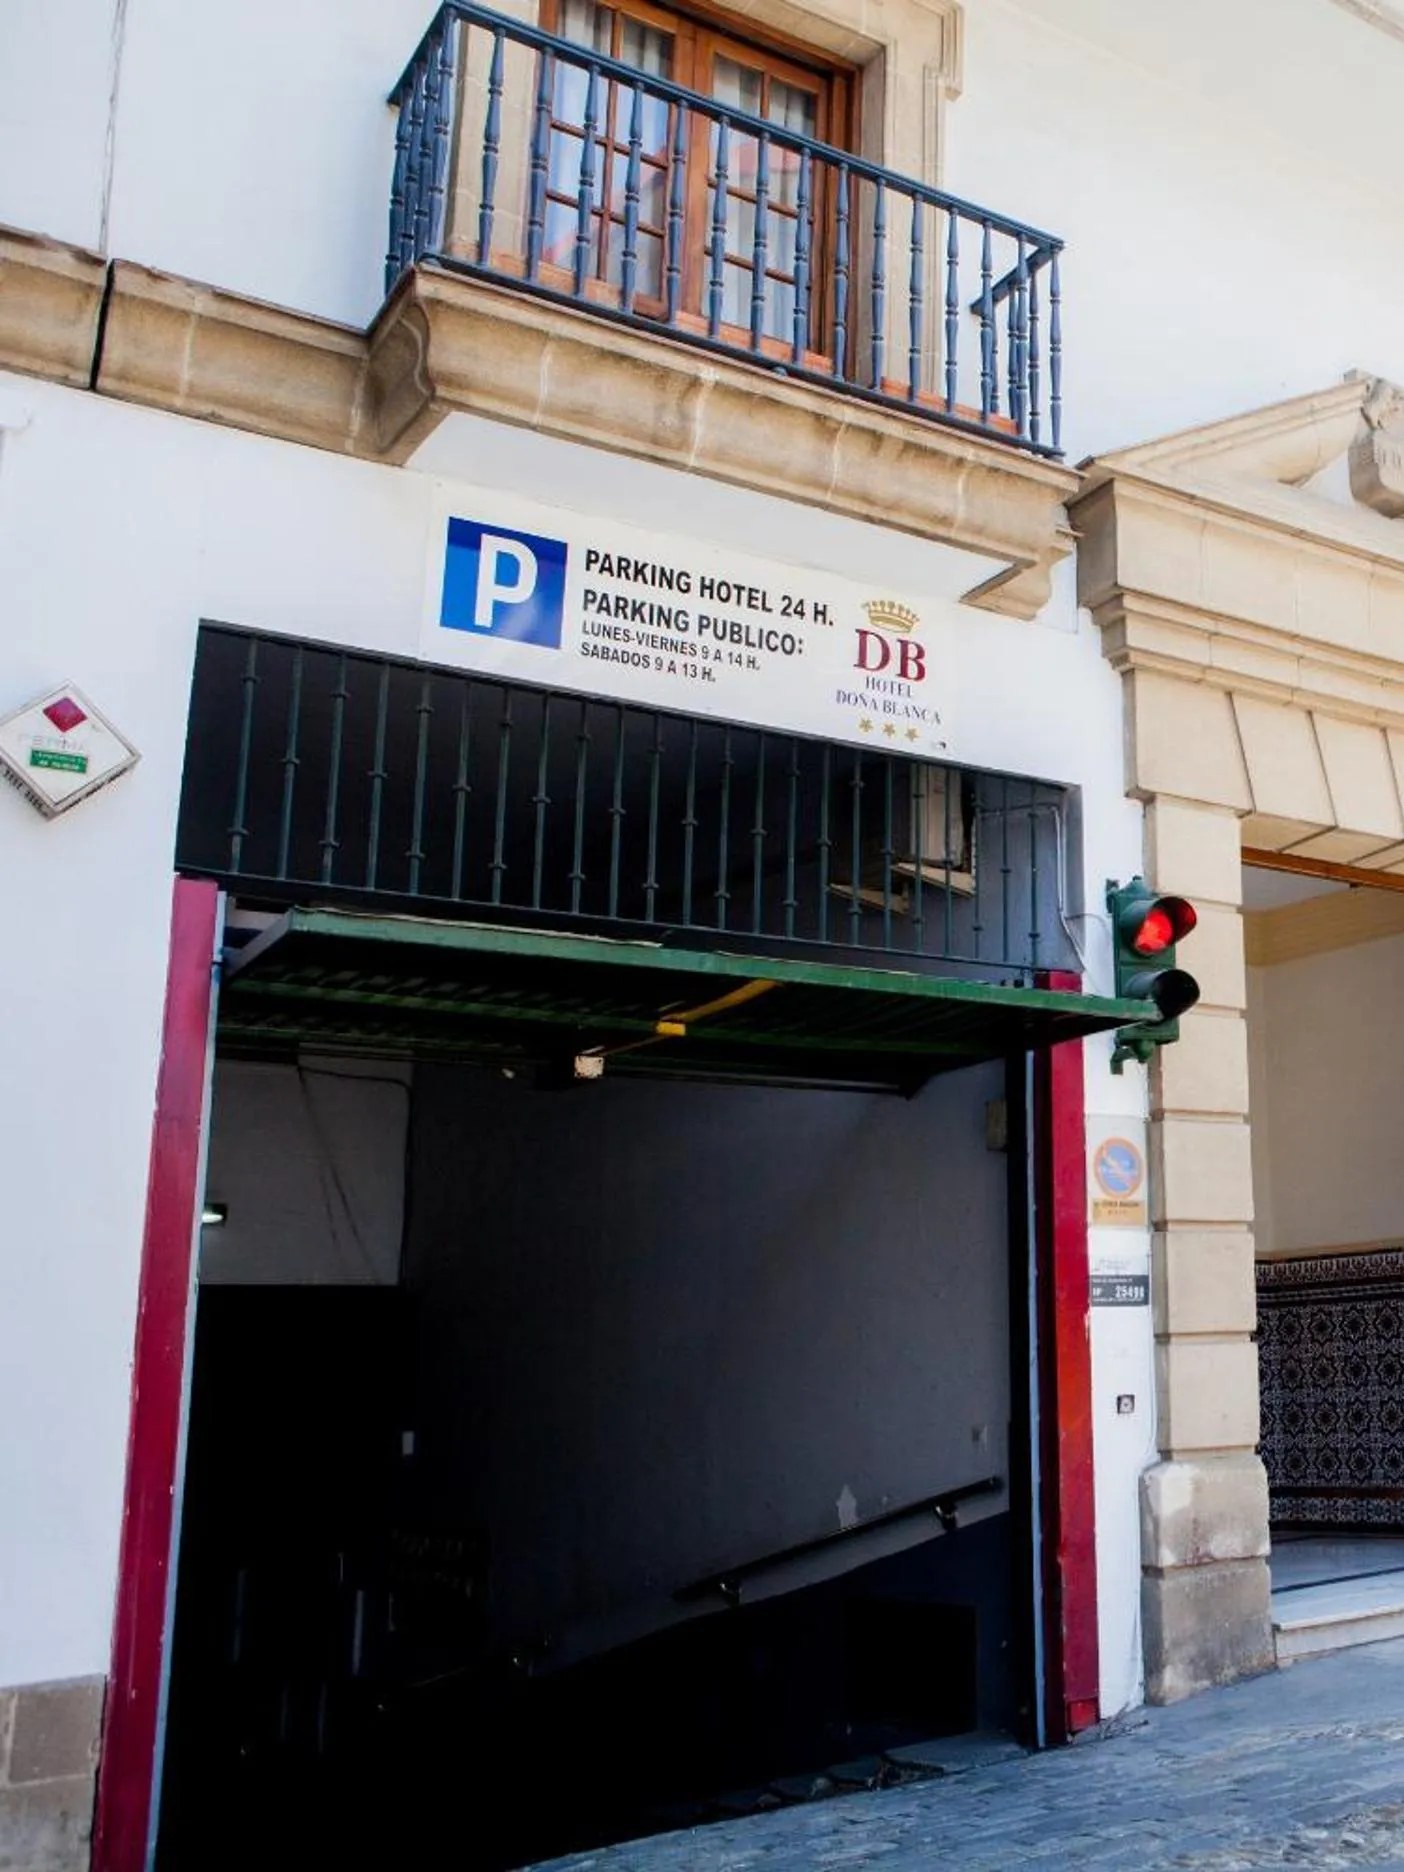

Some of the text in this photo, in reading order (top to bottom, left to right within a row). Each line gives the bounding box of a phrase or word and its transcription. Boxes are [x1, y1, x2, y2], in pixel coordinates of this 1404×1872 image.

[473, 532, 538, 628] P
[585, 549, 835, 627] PARKING HOTEL 24 H.
[582, 619, 761, 671] LUNES-VIERNES 9 A 14 H.
[583, 588, 803, 656] PARKING PUBLICO:
[581, 641, 716, 683] SABADOS 9 A 13 H.
[853, 628, 926, 682] DB
[865, 676, 912, 699] HOTEL
[882, 701, 942, 725] BLANCA
